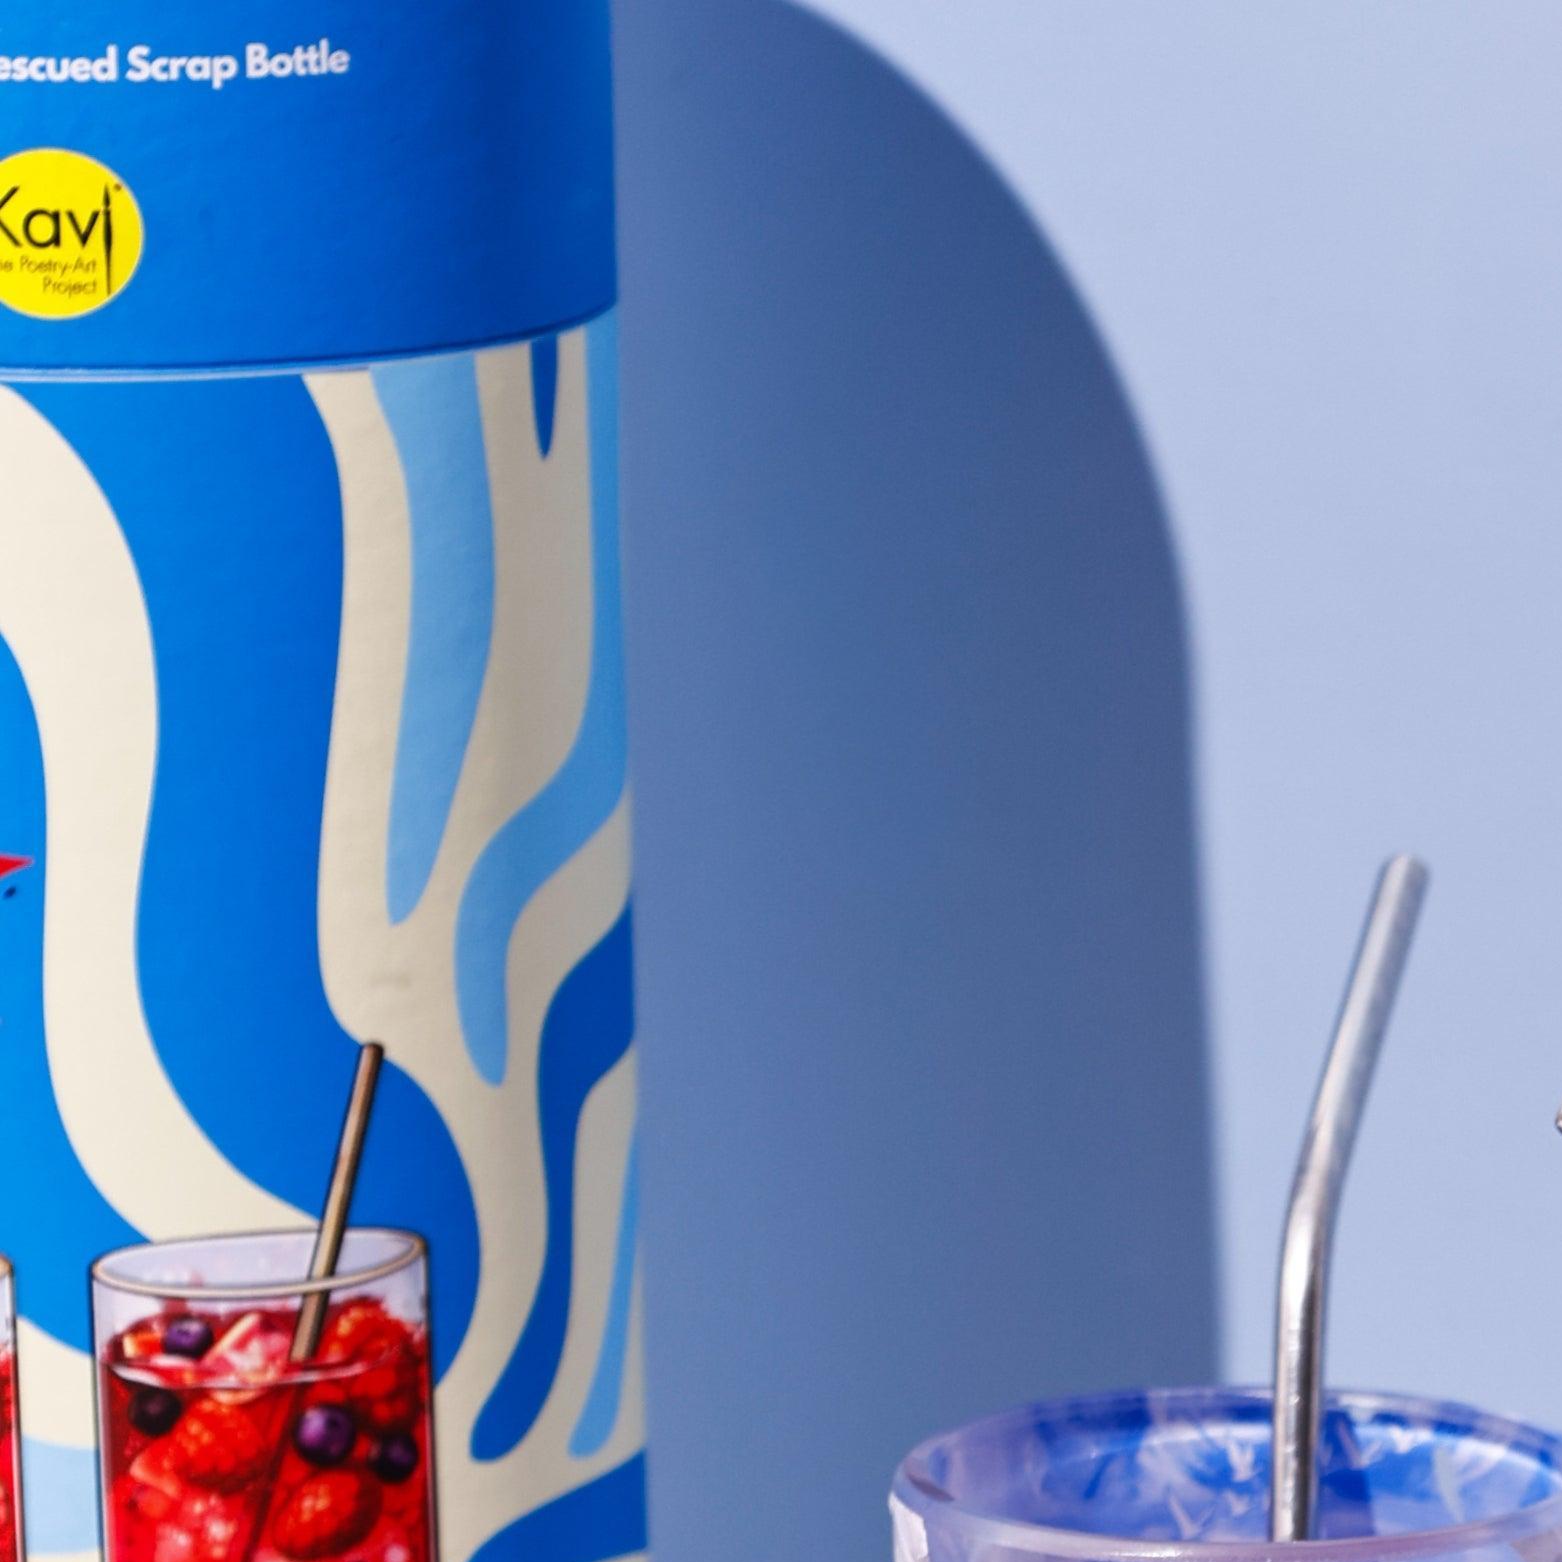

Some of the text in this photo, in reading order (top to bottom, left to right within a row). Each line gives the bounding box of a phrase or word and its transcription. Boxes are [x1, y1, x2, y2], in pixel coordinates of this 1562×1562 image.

[0, 38, 350, 90] escued Scrap Bottle
[42, 275, 97, 299] Project
